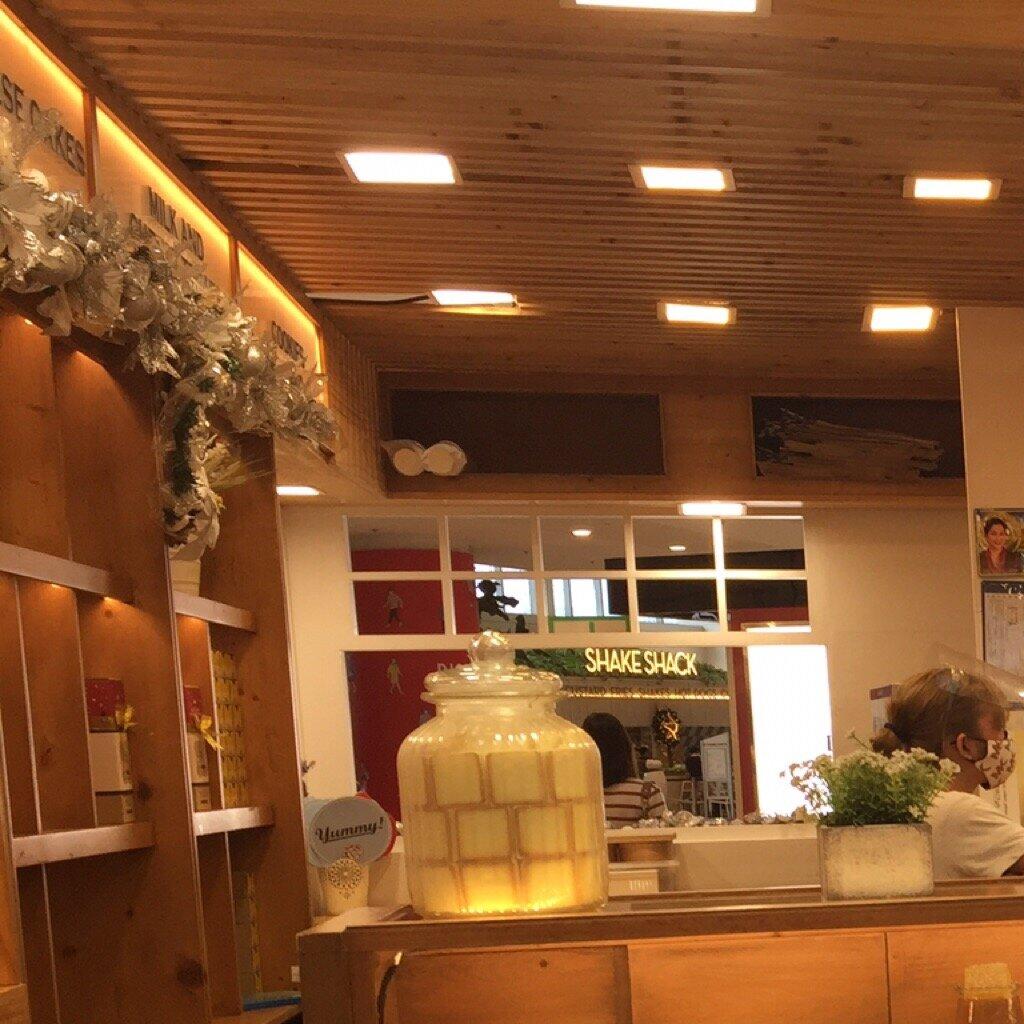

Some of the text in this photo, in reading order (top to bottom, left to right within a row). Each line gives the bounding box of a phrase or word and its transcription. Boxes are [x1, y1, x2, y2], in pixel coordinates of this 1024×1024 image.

[585, 647, 697, 675] SHAKE SHACK
[315, 817, 384, 843] Yummy!
